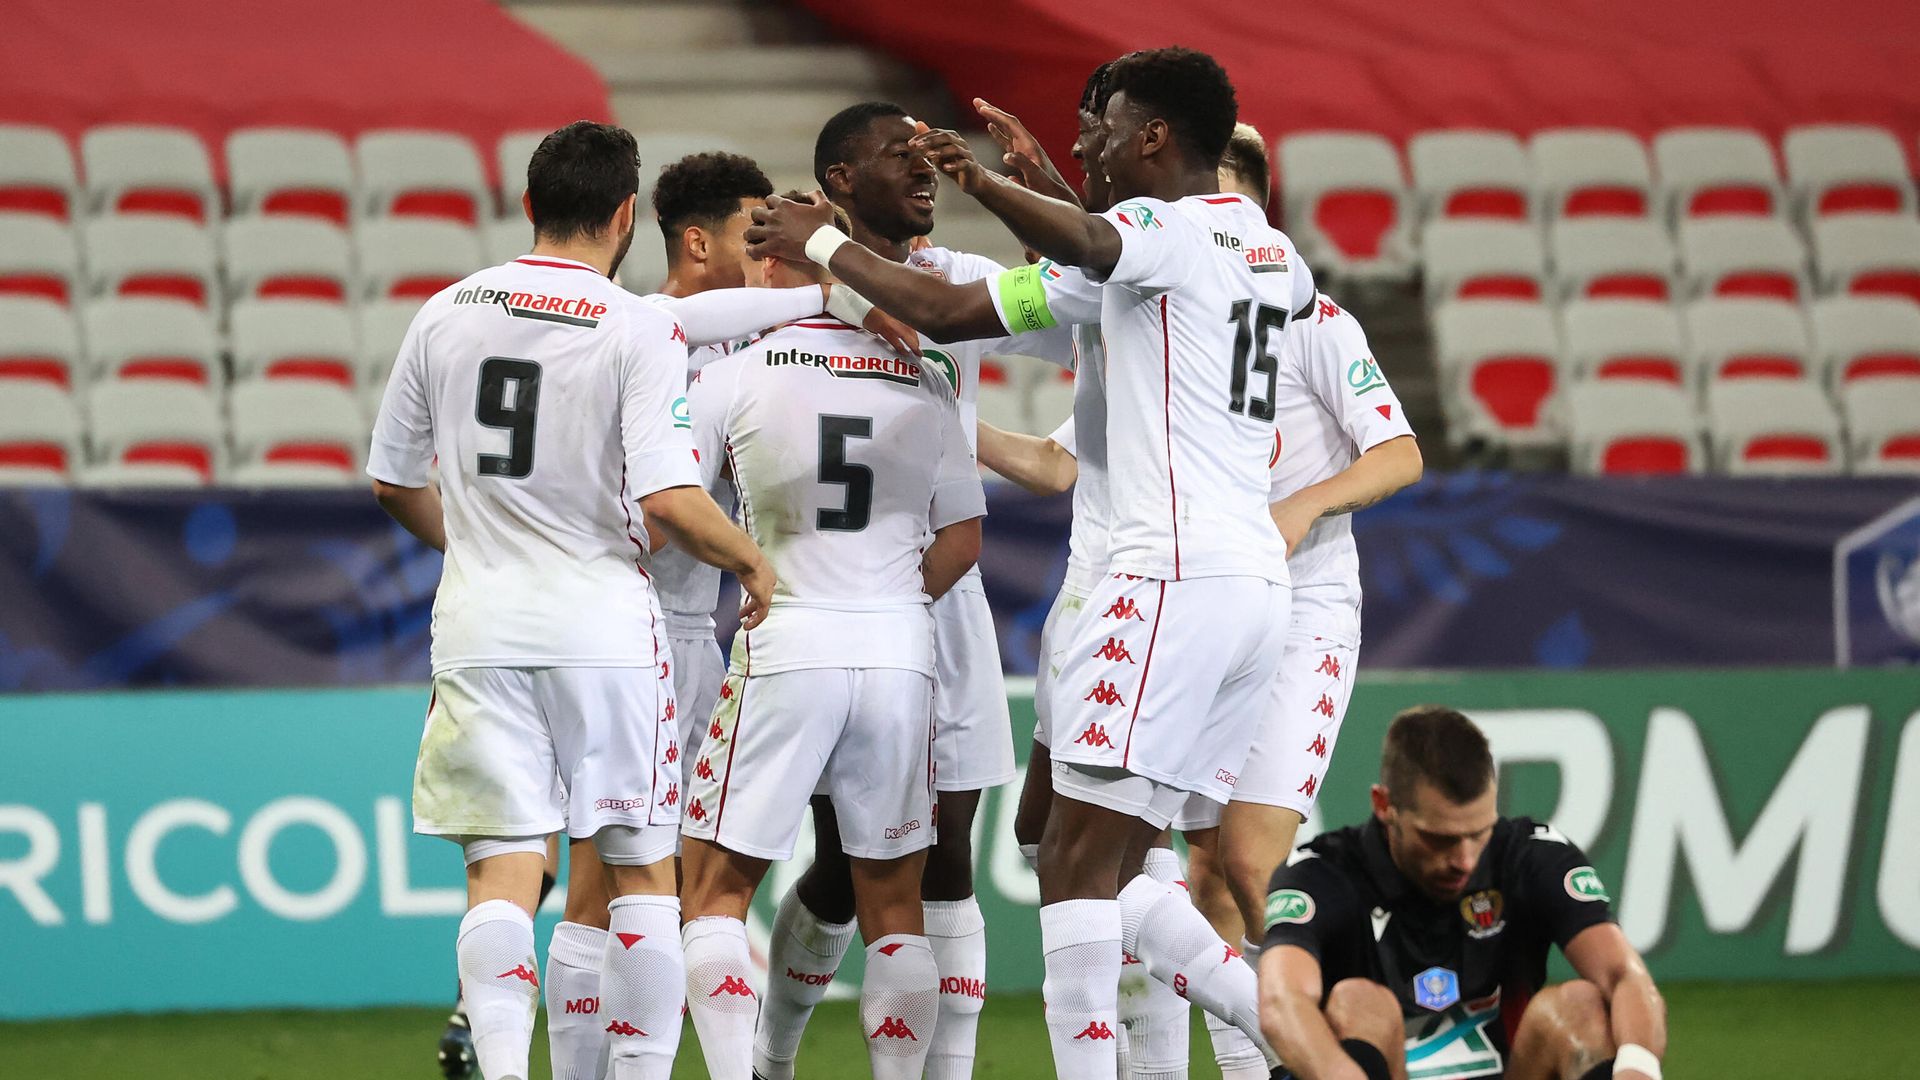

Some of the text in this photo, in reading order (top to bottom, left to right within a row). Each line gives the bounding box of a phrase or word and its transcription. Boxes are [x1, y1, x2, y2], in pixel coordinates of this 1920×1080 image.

[454, 285, 607, 319] Intermarché
[1020, 299, 1040, 331] SPECT
[766, 348, 920, 378] Intermarché
[1228, 298, 1290, 423] 15
[475, 356, 544, 479] 9
[816, 413, 874, 532] 5
[0, 796, 567, 925] RICOL
[1460, 705, 1920, 956] PM
[786, 967, 837, 987] MON
[939, 976, 987, 1000] MONAC
